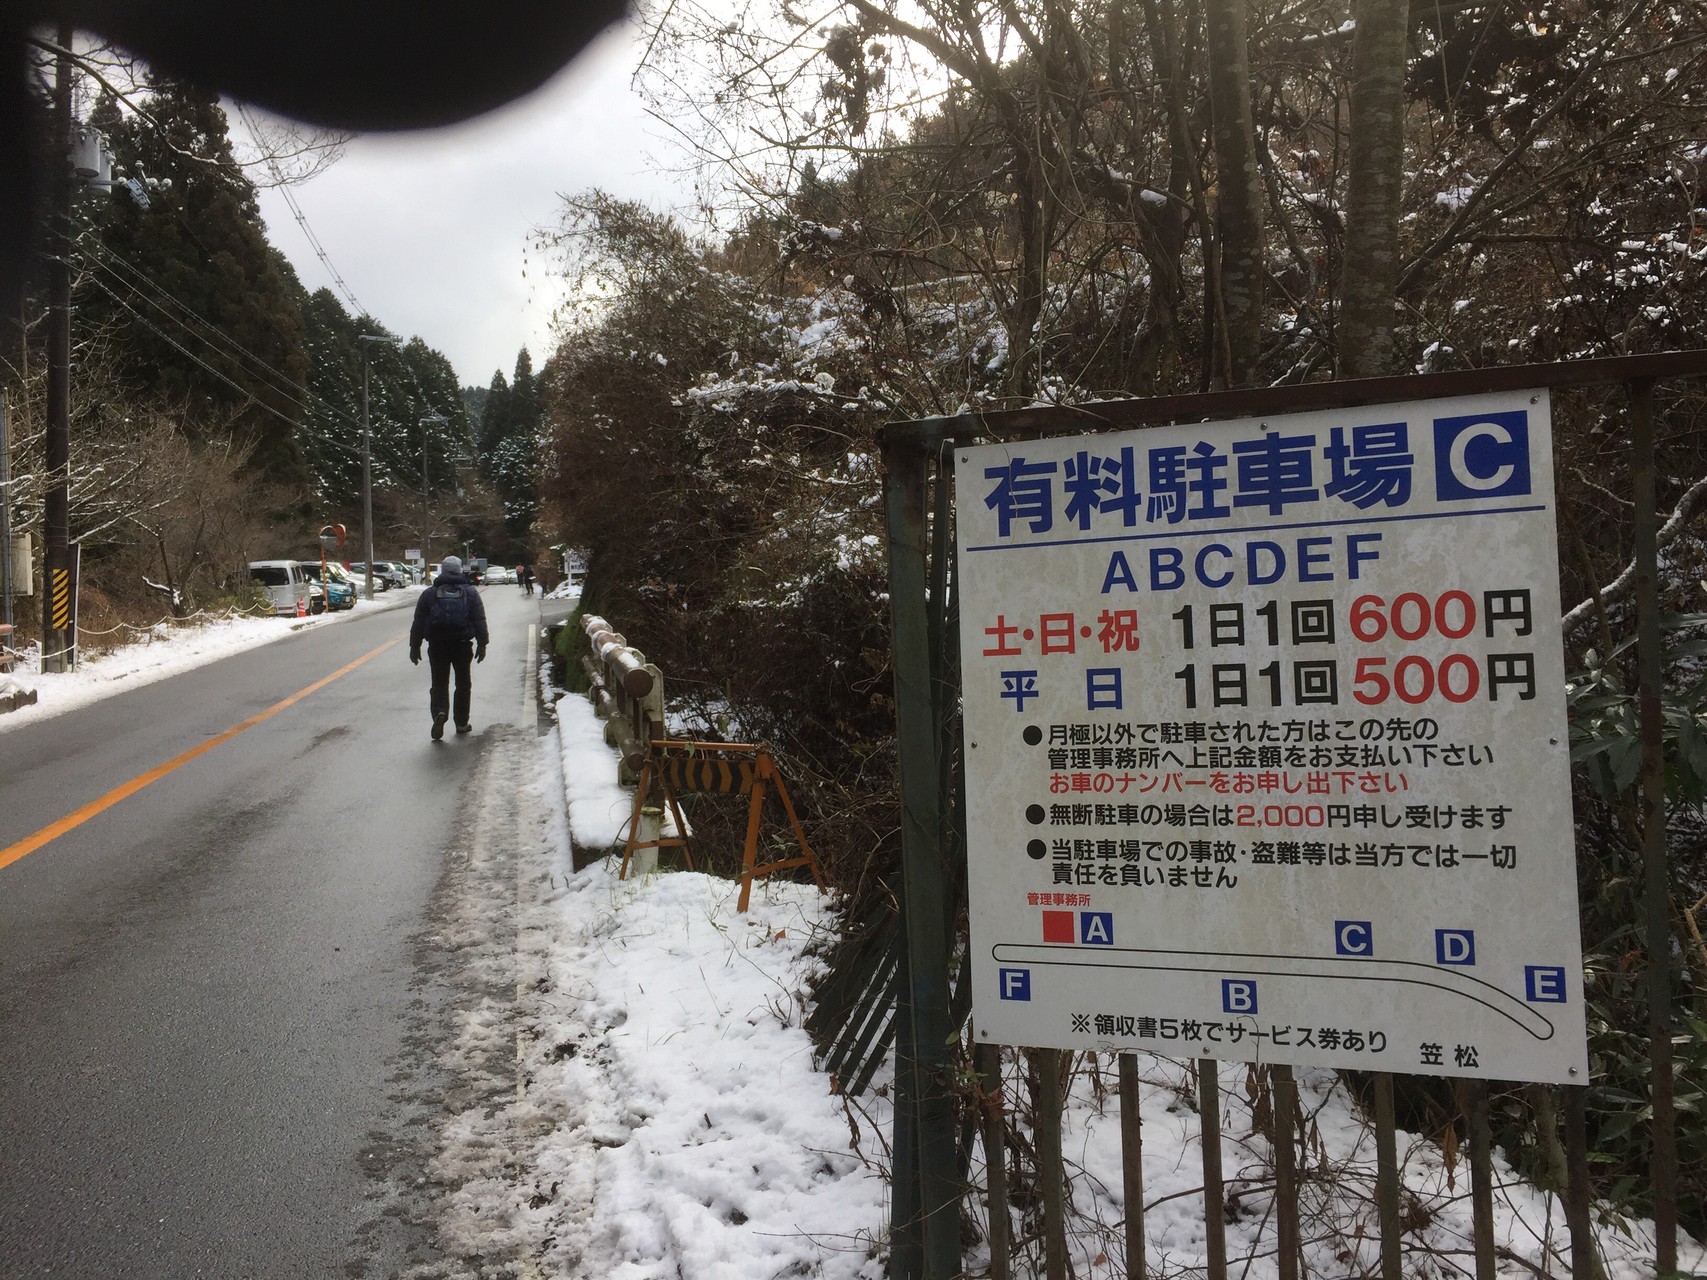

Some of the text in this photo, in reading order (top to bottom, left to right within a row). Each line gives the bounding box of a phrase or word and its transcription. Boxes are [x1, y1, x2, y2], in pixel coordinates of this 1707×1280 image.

[983, 422, 1514, 537] 有料駐車場 C
[1048, 719, 1438, 744] 月極以外で駐車された方はこの先の
[1048, 743, 1493, 769] 管理事務所へ上記金額をお支払い下さい
[1050, 771, 1408, 794] お車のナンバーをお申し出下さい
[1052, 839, 1516, 870] 当駐車場での事故・盗難等は当方では一切
[1052, 863, 1237, 888] 責任を負いません
[1027, 893, 1090, 906] 管理事務所
[1087, 916, 1108, 941] A
[1341, 925, 1366, 952] C
[1444, 934, 1469, 961] D
[1006, 972, 1023, 997] F
[1229, 983, 1251, 1010] B
[1534, 970, 1558, 999] E
